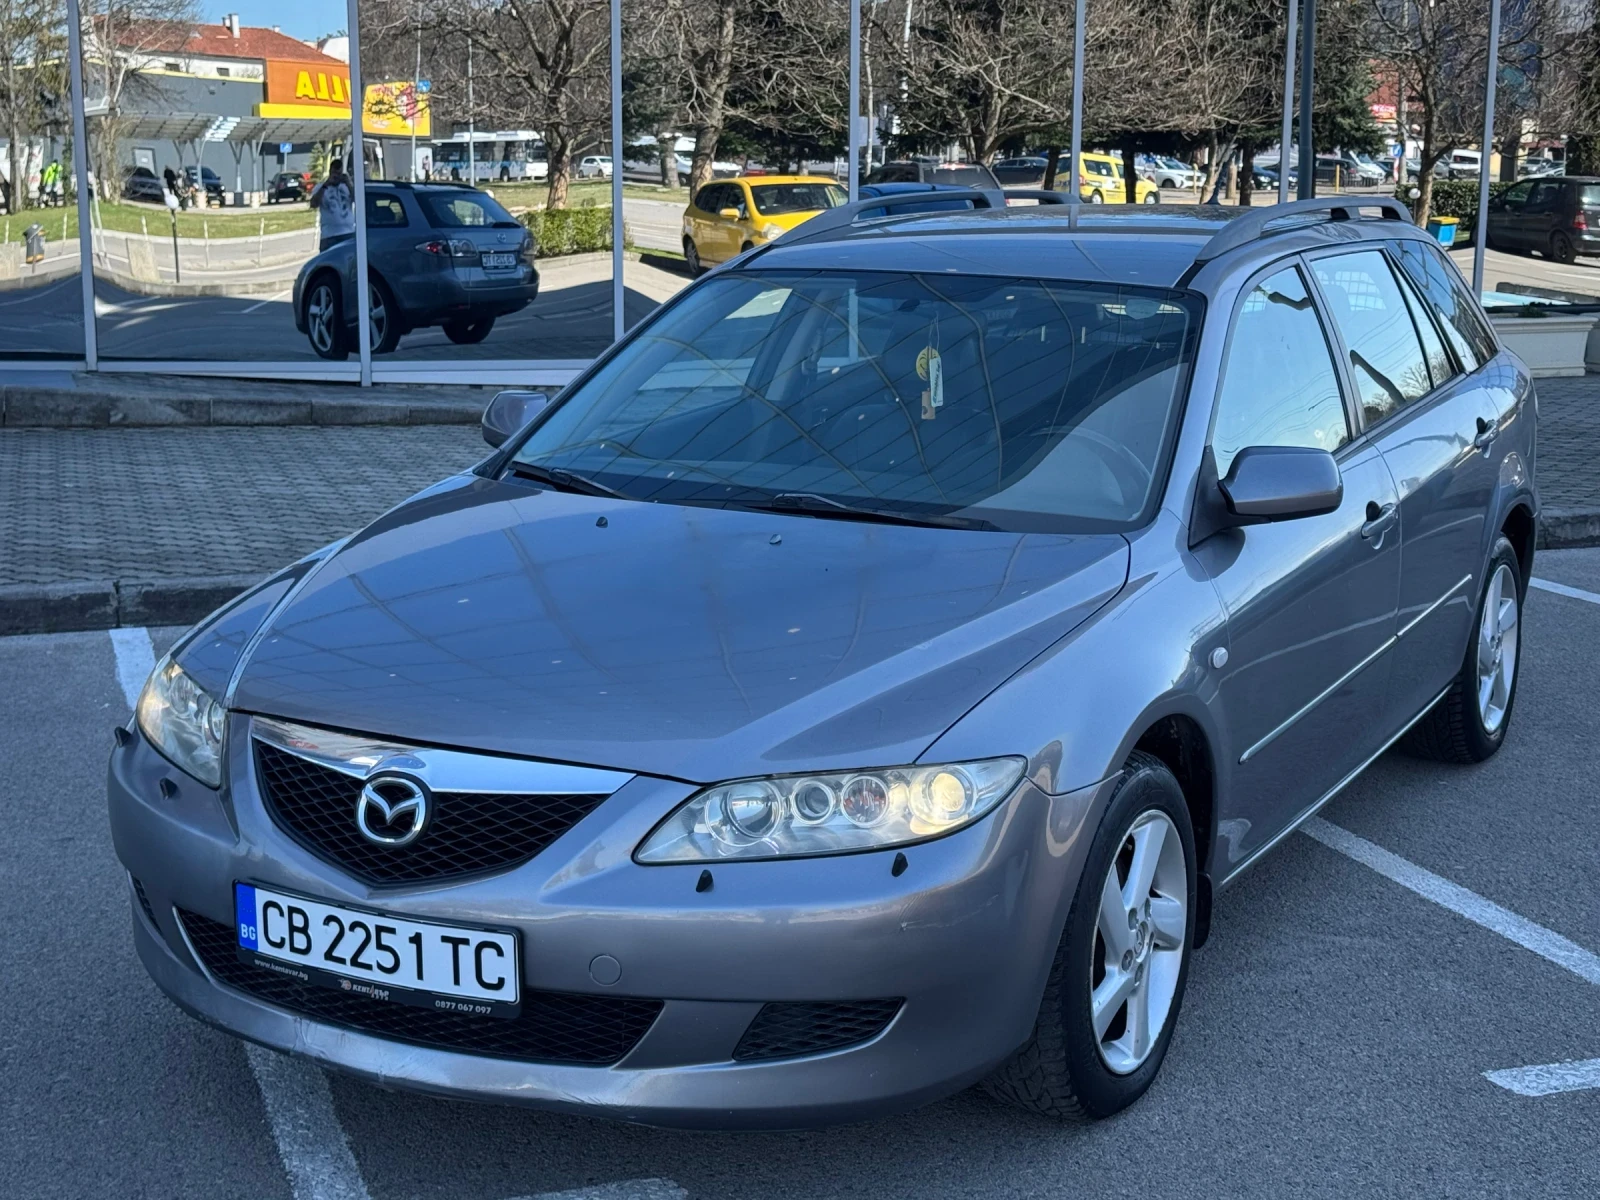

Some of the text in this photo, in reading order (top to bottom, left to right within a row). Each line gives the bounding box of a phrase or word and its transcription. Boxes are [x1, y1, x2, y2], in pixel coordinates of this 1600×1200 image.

[240, 923, 256, 941] BG
[262, 900, 505, 991] CB 2251 TC
[254, 958, 309, 981] www.kentavar.bg
[435, 1000, 492, 1014] 0877 067 097
